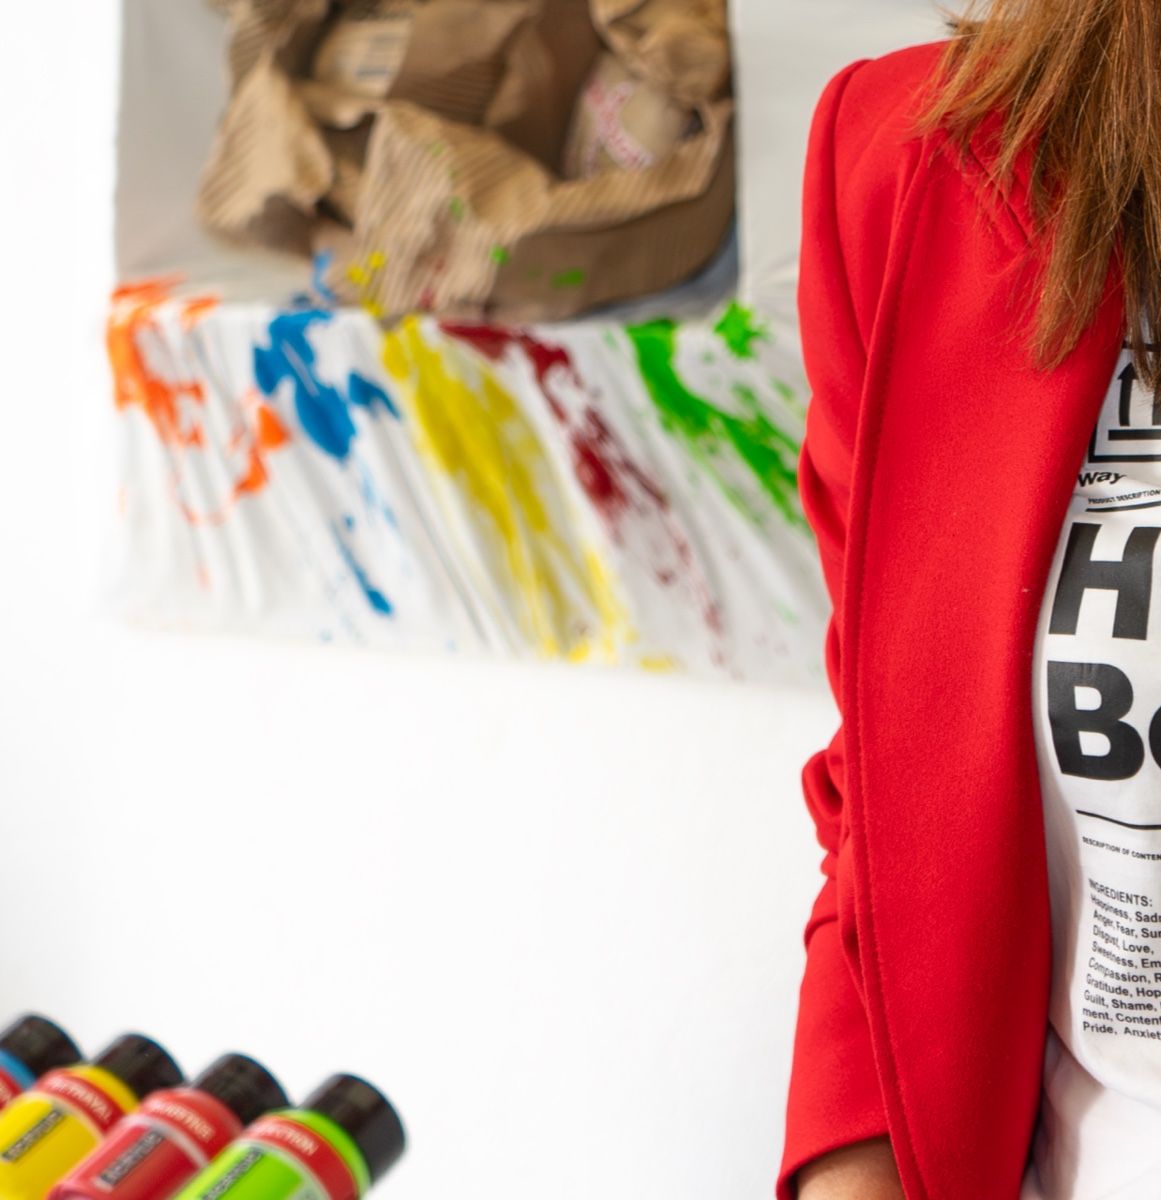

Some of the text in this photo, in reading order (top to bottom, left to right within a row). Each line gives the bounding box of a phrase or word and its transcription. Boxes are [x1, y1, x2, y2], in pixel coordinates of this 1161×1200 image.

[1116, 489, 1161, 502] DESCRIPTION
[1082, 836, 1121, 853] DESCRIPTION
[1088, 878, 1153, 907] INGREDIENTS:
[1116, 921, 1138, 938] Fear,
[1092, 941, 1138, 969] Sweetness,
[1122, 940, 1154, 955] Love,
[1088, 957, 1151, 984] Compassion,
[1086, 973, 1133, 998] Gratitude,
[1084, 990, 1109, 1008] Guilt,
[1112, 999, 1157, 1012] Shame,
[1082, 1008, 1113, 1021] ment,
[1083, 1021, 1117, 1035] Pride,
